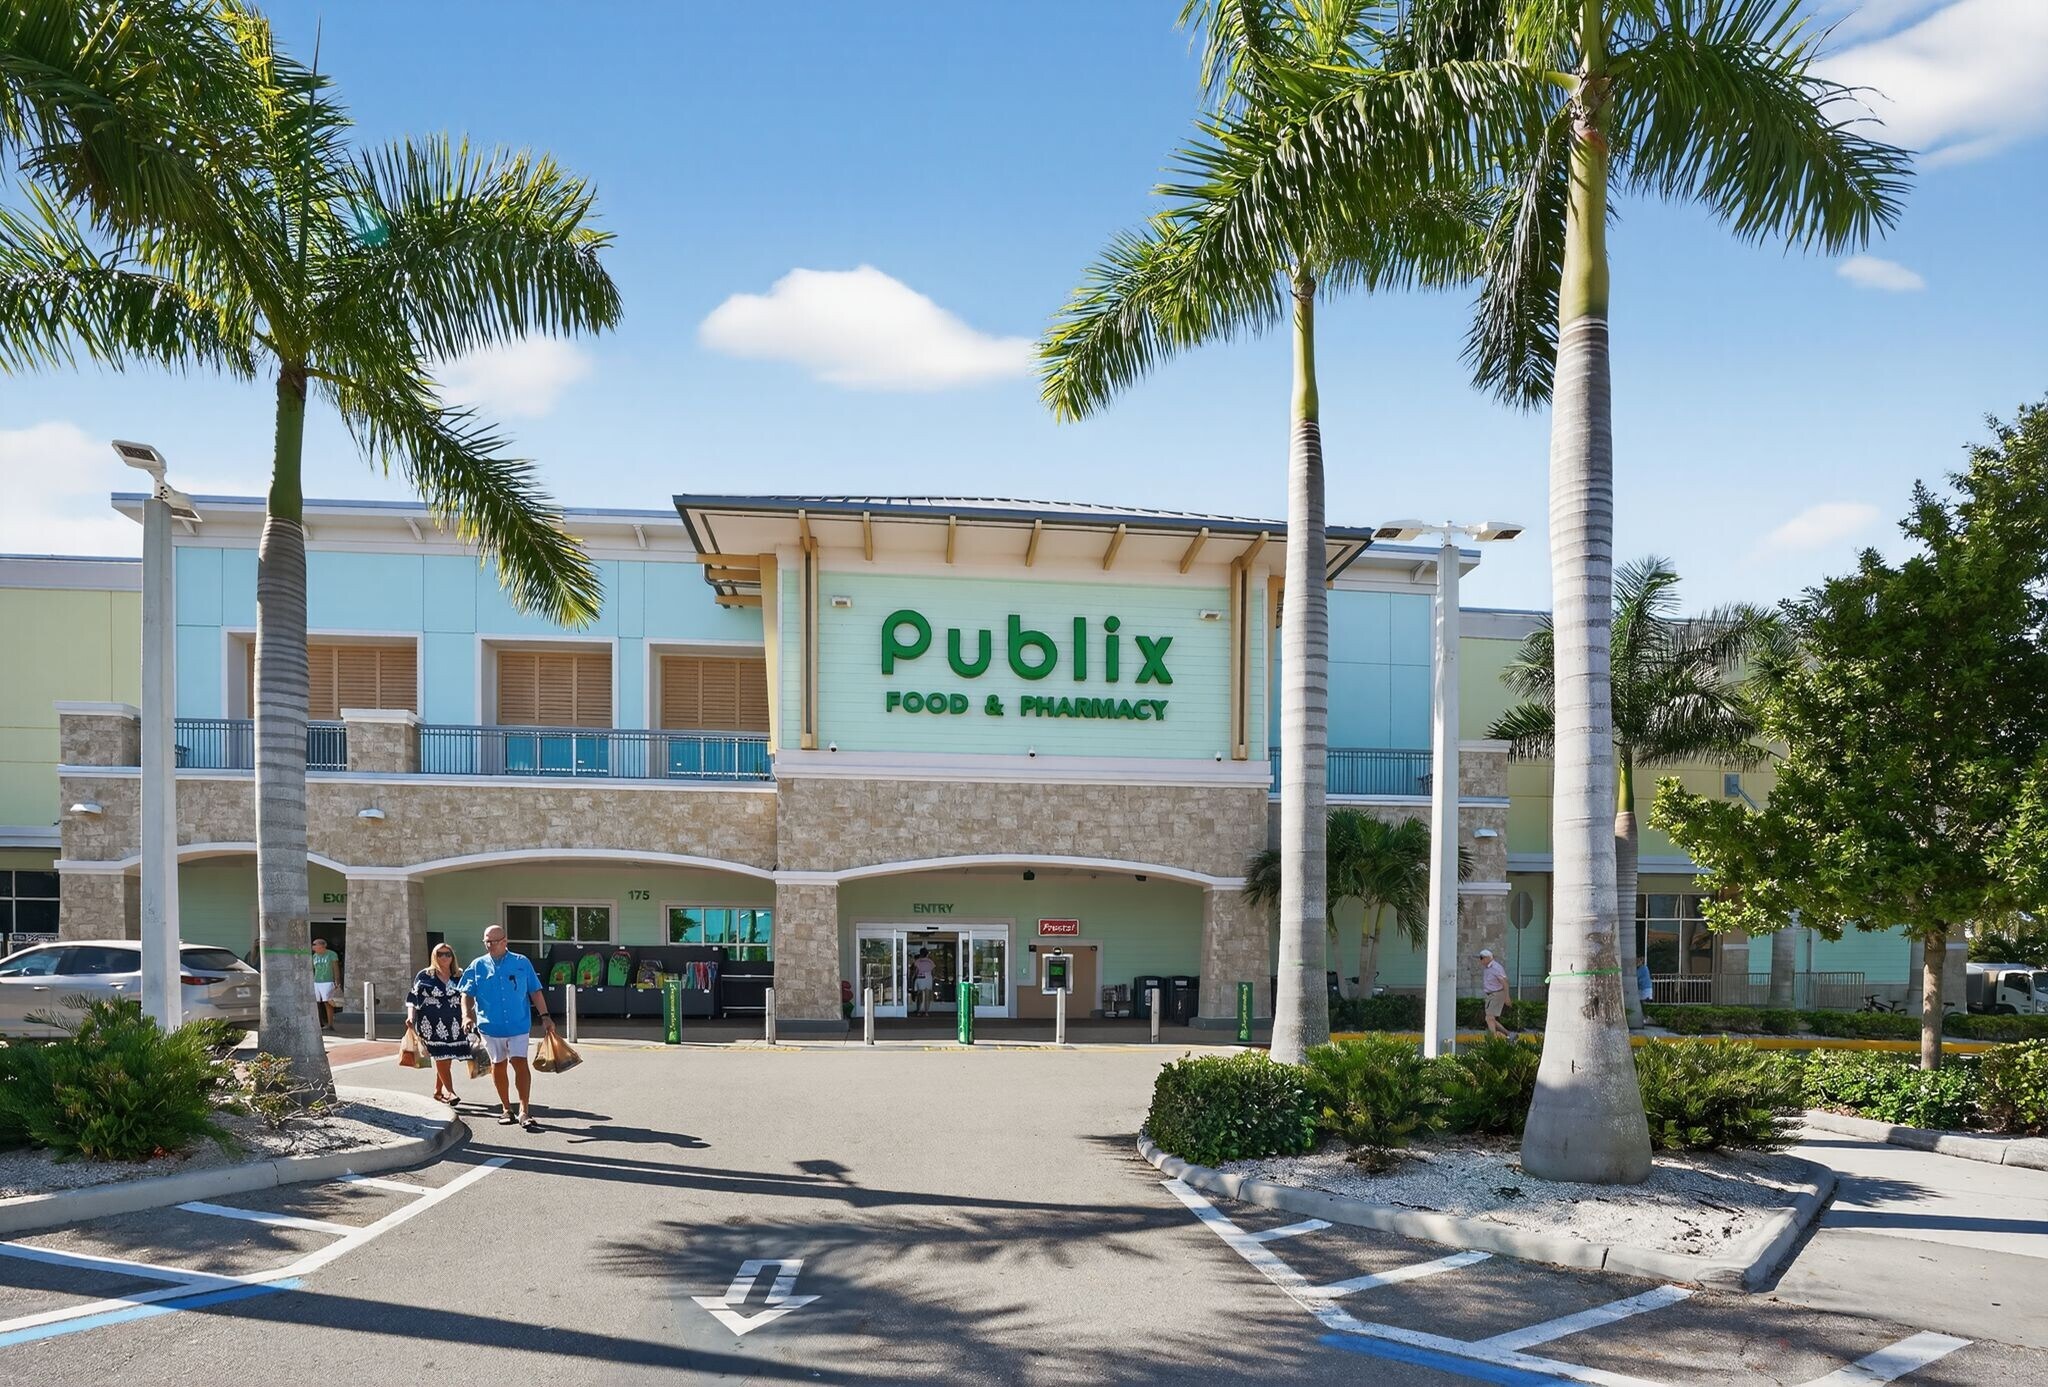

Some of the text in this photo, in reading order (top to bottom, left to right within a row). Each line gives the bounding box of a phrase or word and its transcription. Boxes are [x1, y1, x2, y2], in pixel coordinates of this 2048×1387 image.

[881, 609, 1173, 684] Publix
[886, 691, 1169, 721] FOOD & PHARMACY
[323, 893, 348, 903] EXI
[628, 890, 650, 900] 175
[913, 903, 954, 913] ENTRY
